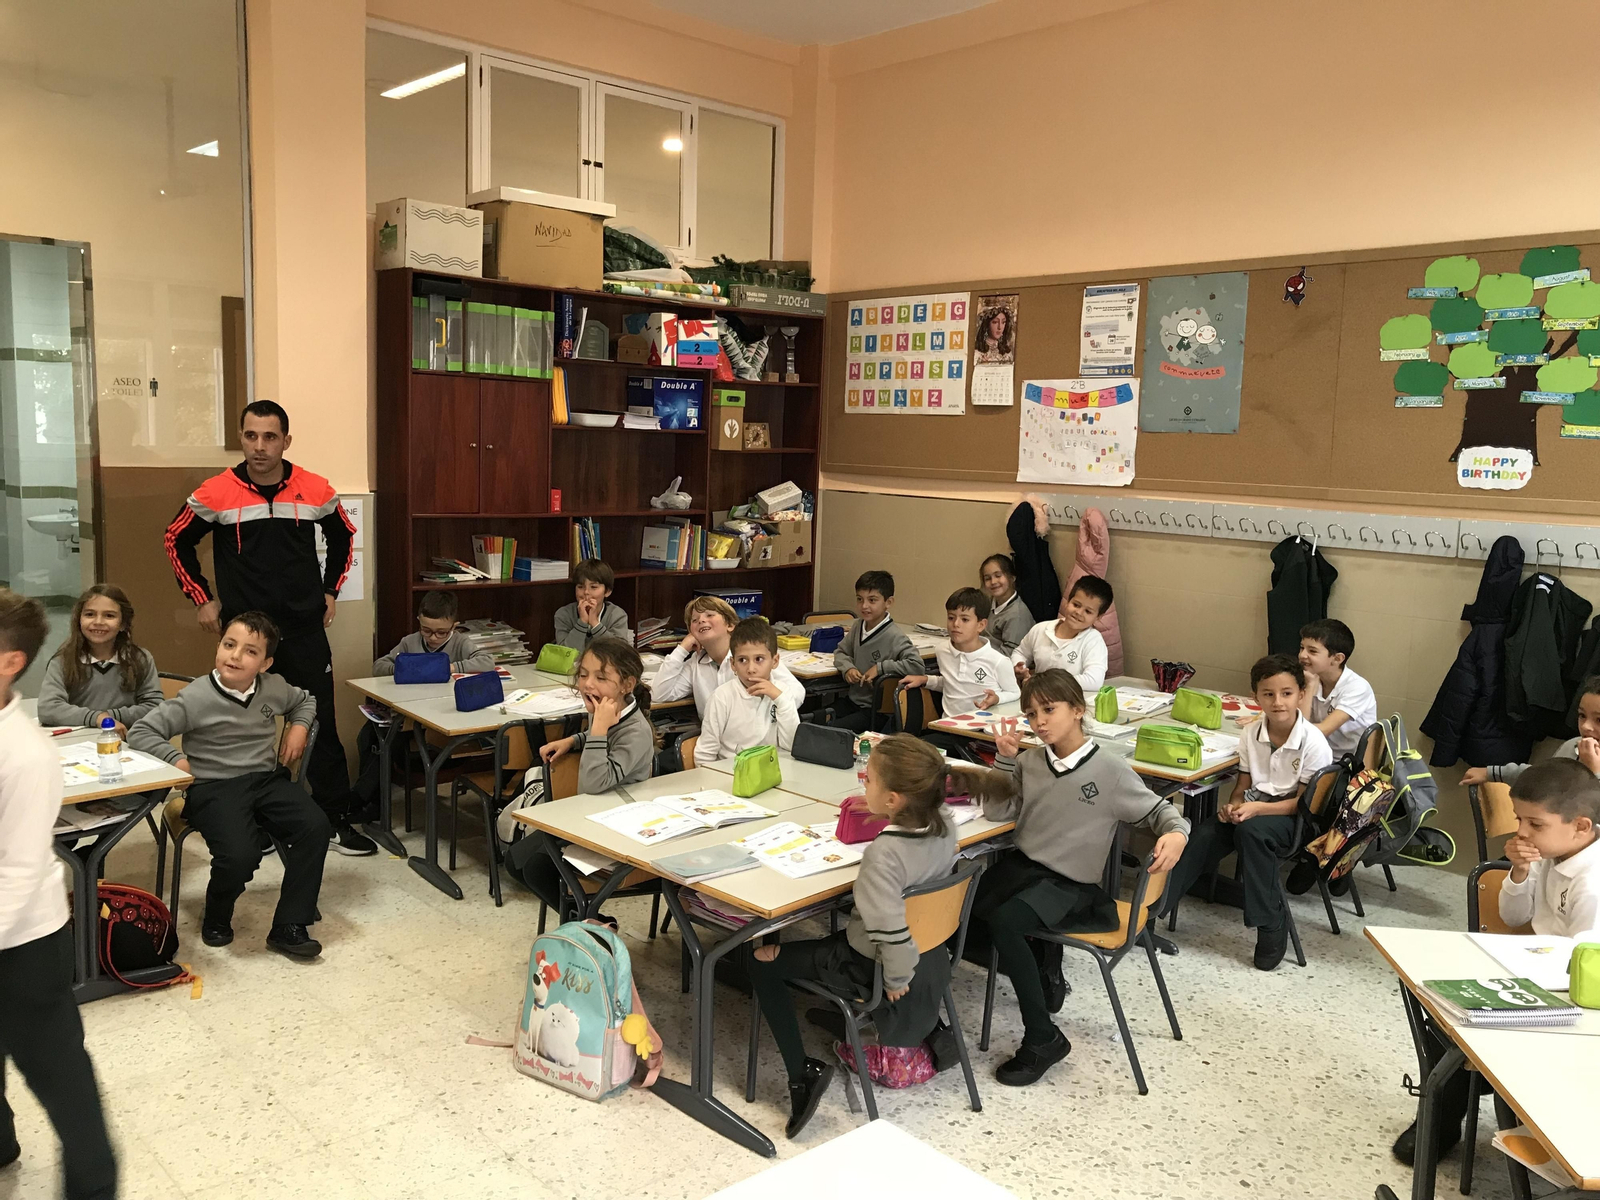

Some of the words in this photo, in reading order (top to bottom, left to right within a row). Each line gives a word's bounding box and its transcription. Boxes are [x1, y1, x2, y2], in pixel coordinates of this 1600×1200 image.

[534, 221, 572, 242] NAVIDAD
[853, 311, 860, 320] A
[869, 310, 875, 319] B
[884, 309, 890, 319] C
[901, 308, 908, 318] D
[917, 306, 924, 317] E
[936, 305, 942, 315] F
[954, 304, 962, 315] G
[853, 338, 859, 347] H
[869, 337, 872, 346] I
[884, 337, 889, 346] J
[900, 336, 906, 346] K
[917, 336, 922, 346] L
[933, 335, 942, 346] M
[953, 334, 960, 344] N
[694, 343, 700, 352] 2
[697, 357, 702, 365] 2
[867, 365, 873, 374] O
[883, 365, 889, 374] P
[898, 364, 904, 374] Q
[914, 364, 921, 374] R
[932, 363, 940, 373] S
[952, 364, 959, 374] T
[113, 378, 141, 386] ASEO
[661, 382, 687, 390] Double
[851, 392, 857, 401] U
[866, 392, 872, 401] V
[880, 392, 888, 401] W
[898, 392, 904, 401] X
[913, 392, 920, 402] Y
[931, 392, 938, 402] Z
[1473, 457, 1518, 467] HAPPY
[1462, 469, 1526, 480] BIRTHDAY
[1078, 797, 1095, 805] LICEO
